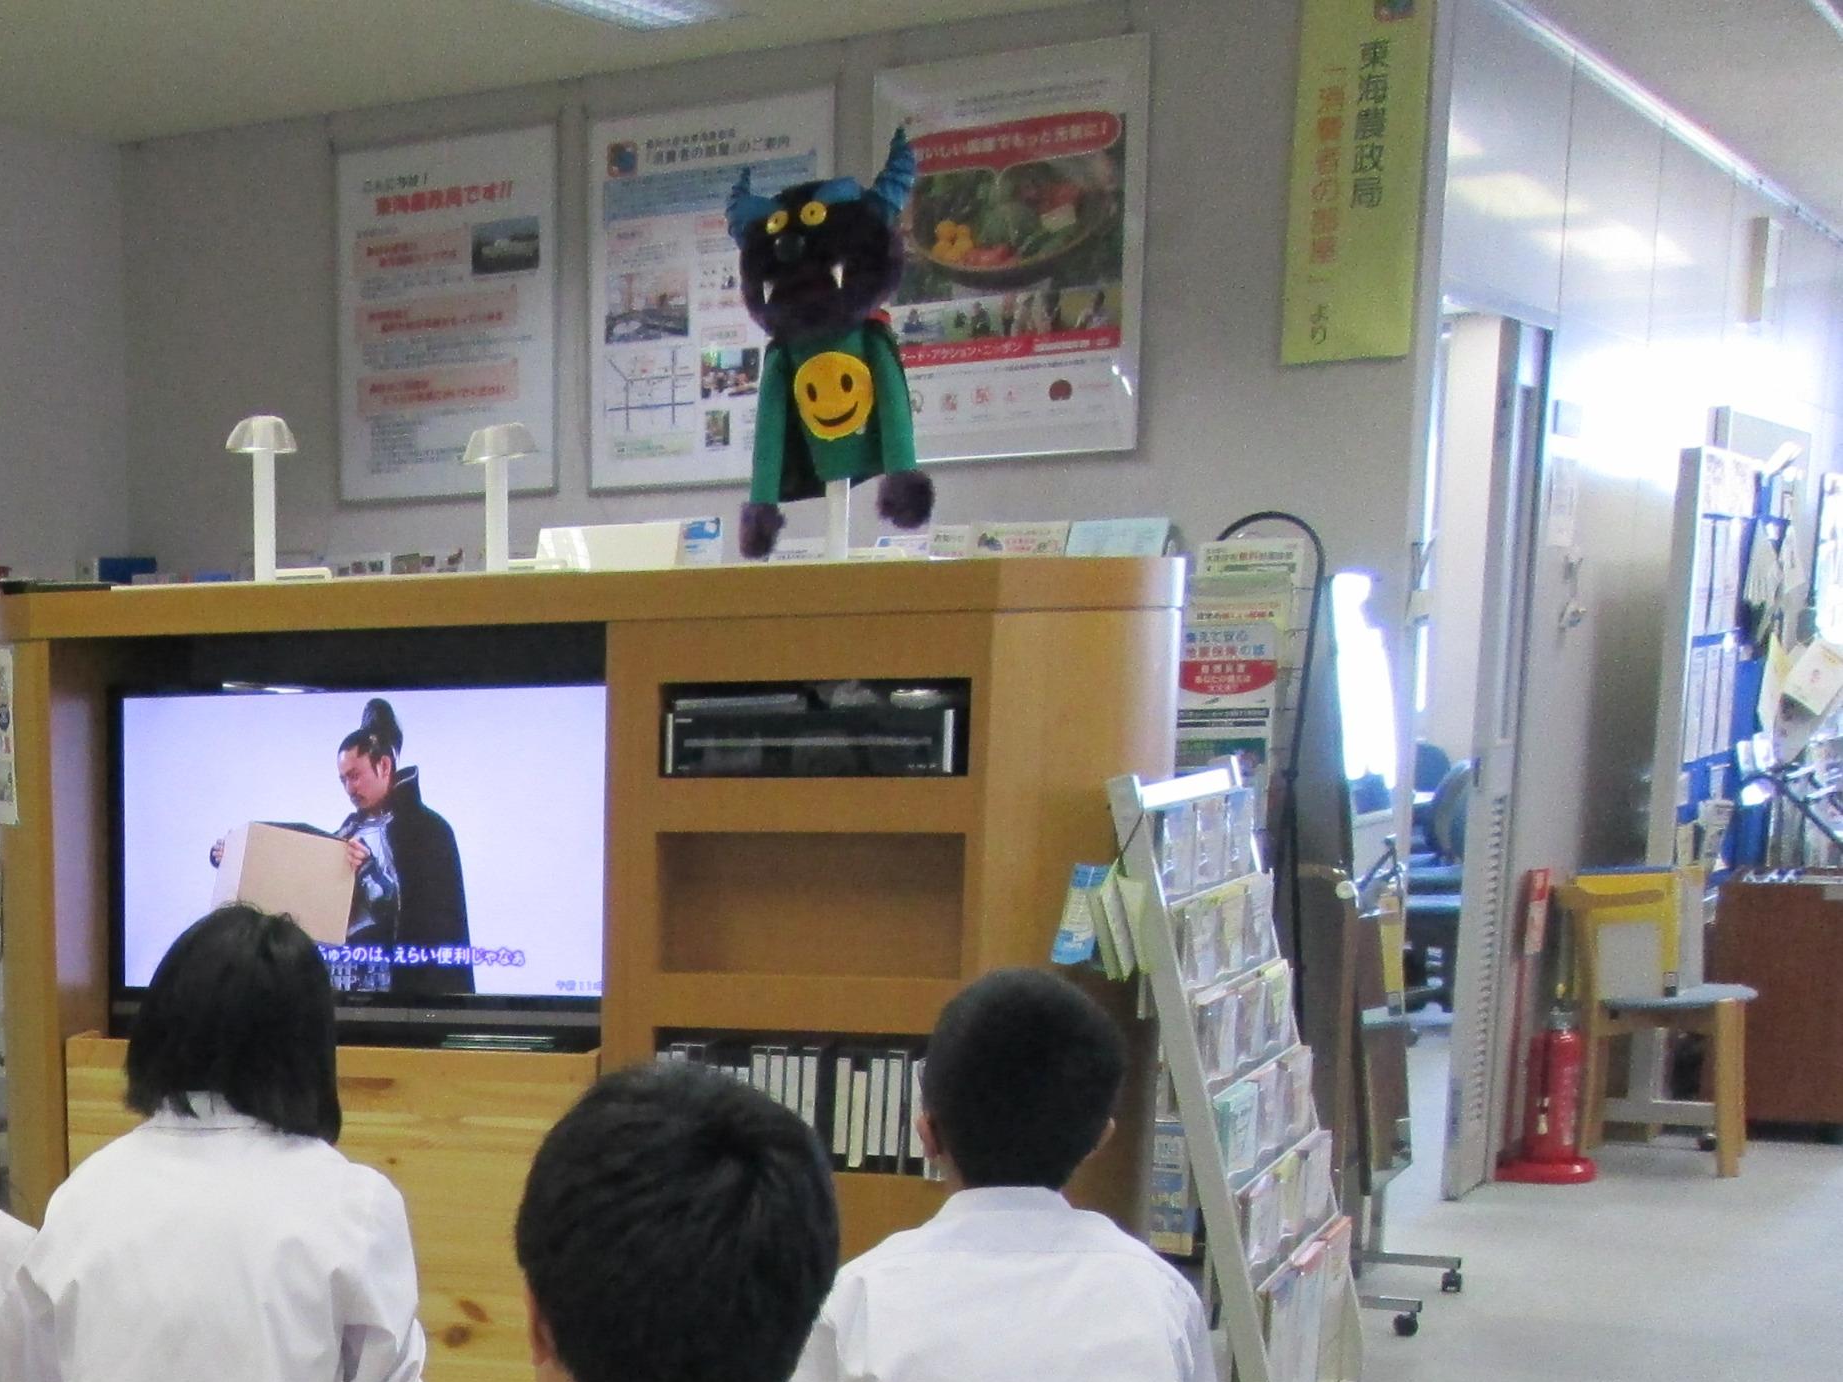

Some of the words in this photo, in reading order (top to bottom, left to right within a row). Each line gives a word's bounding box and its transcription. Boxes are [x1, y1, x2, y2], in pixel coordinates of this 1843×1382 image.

[1350, 38, 1390, 209] 東海農政局
